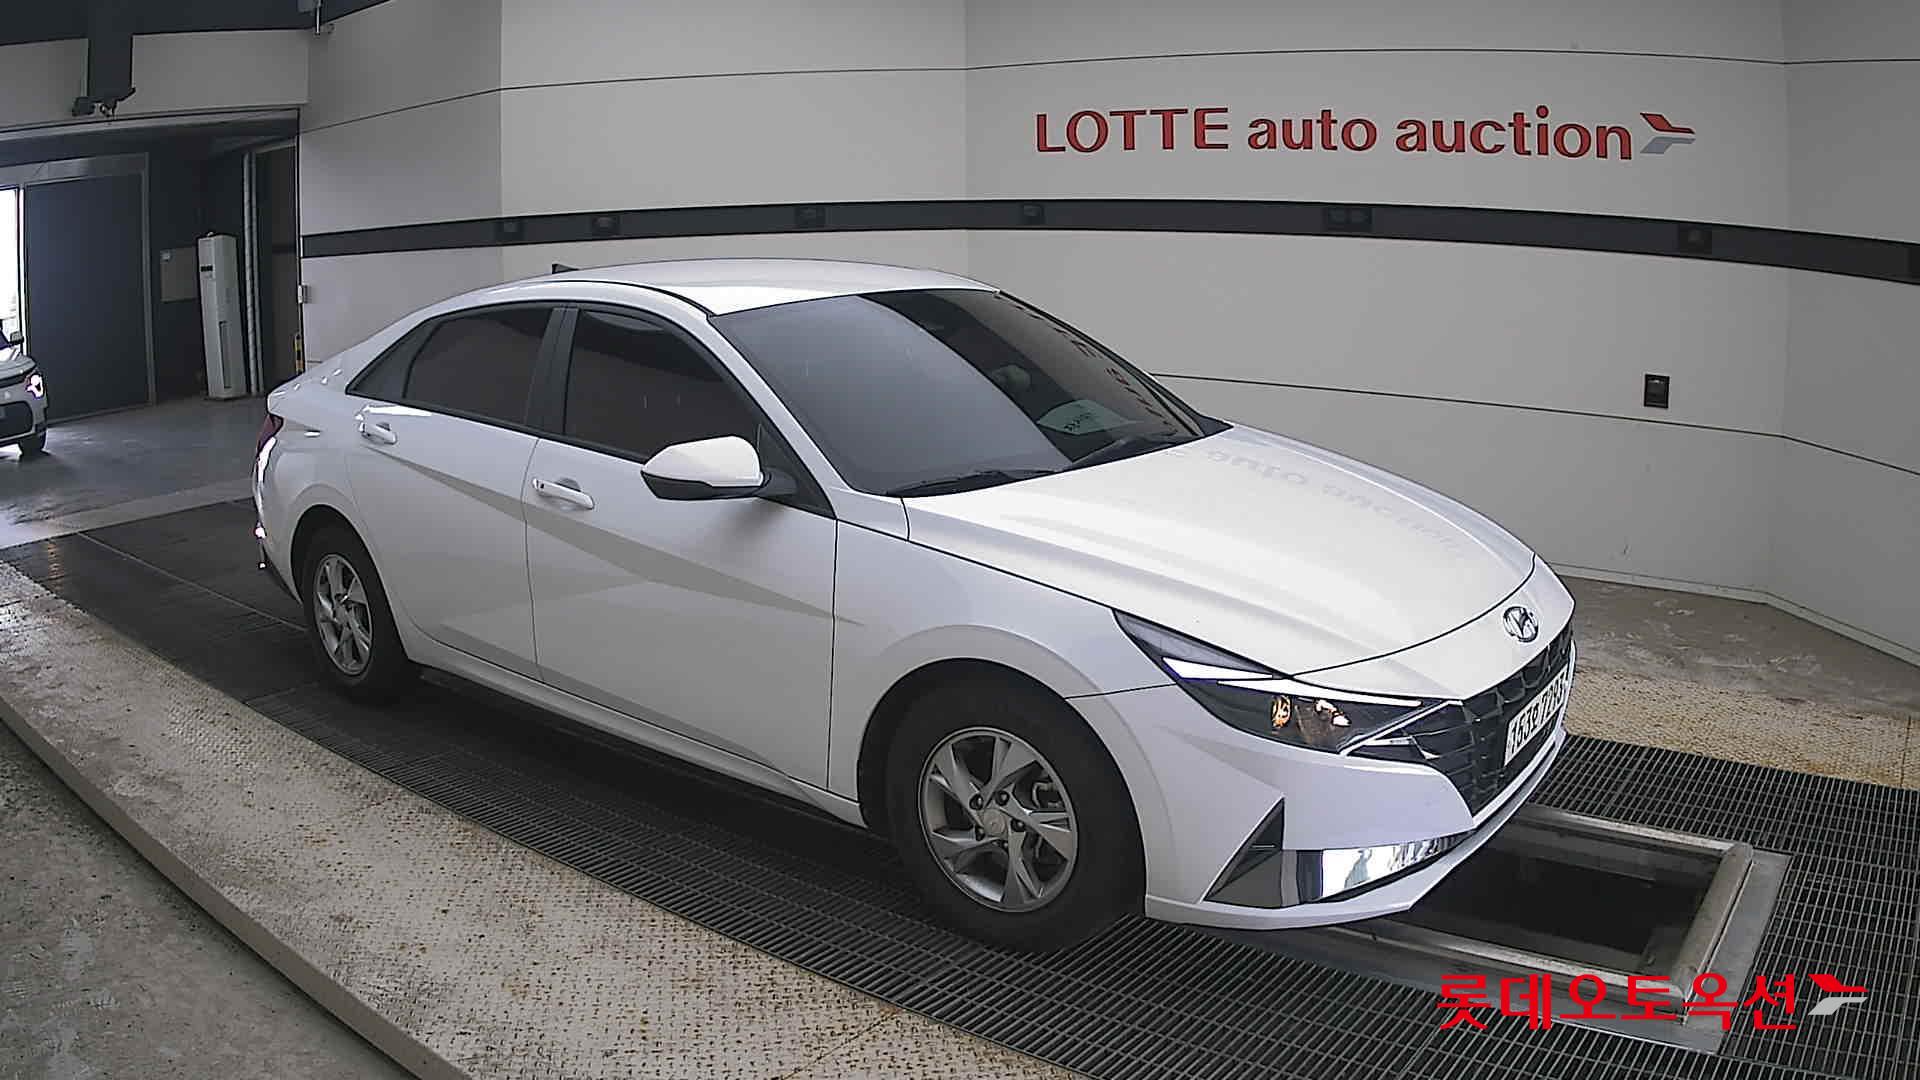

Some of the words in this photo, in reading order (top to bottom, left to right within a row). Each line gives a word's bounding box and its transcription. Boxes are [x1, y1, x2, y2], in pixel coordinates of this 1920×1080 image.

[1036, 107, 1229, 153] LOTTE
[1247, 110, 1378, 151] auto
[1395, 106, 1632, 160] auction
